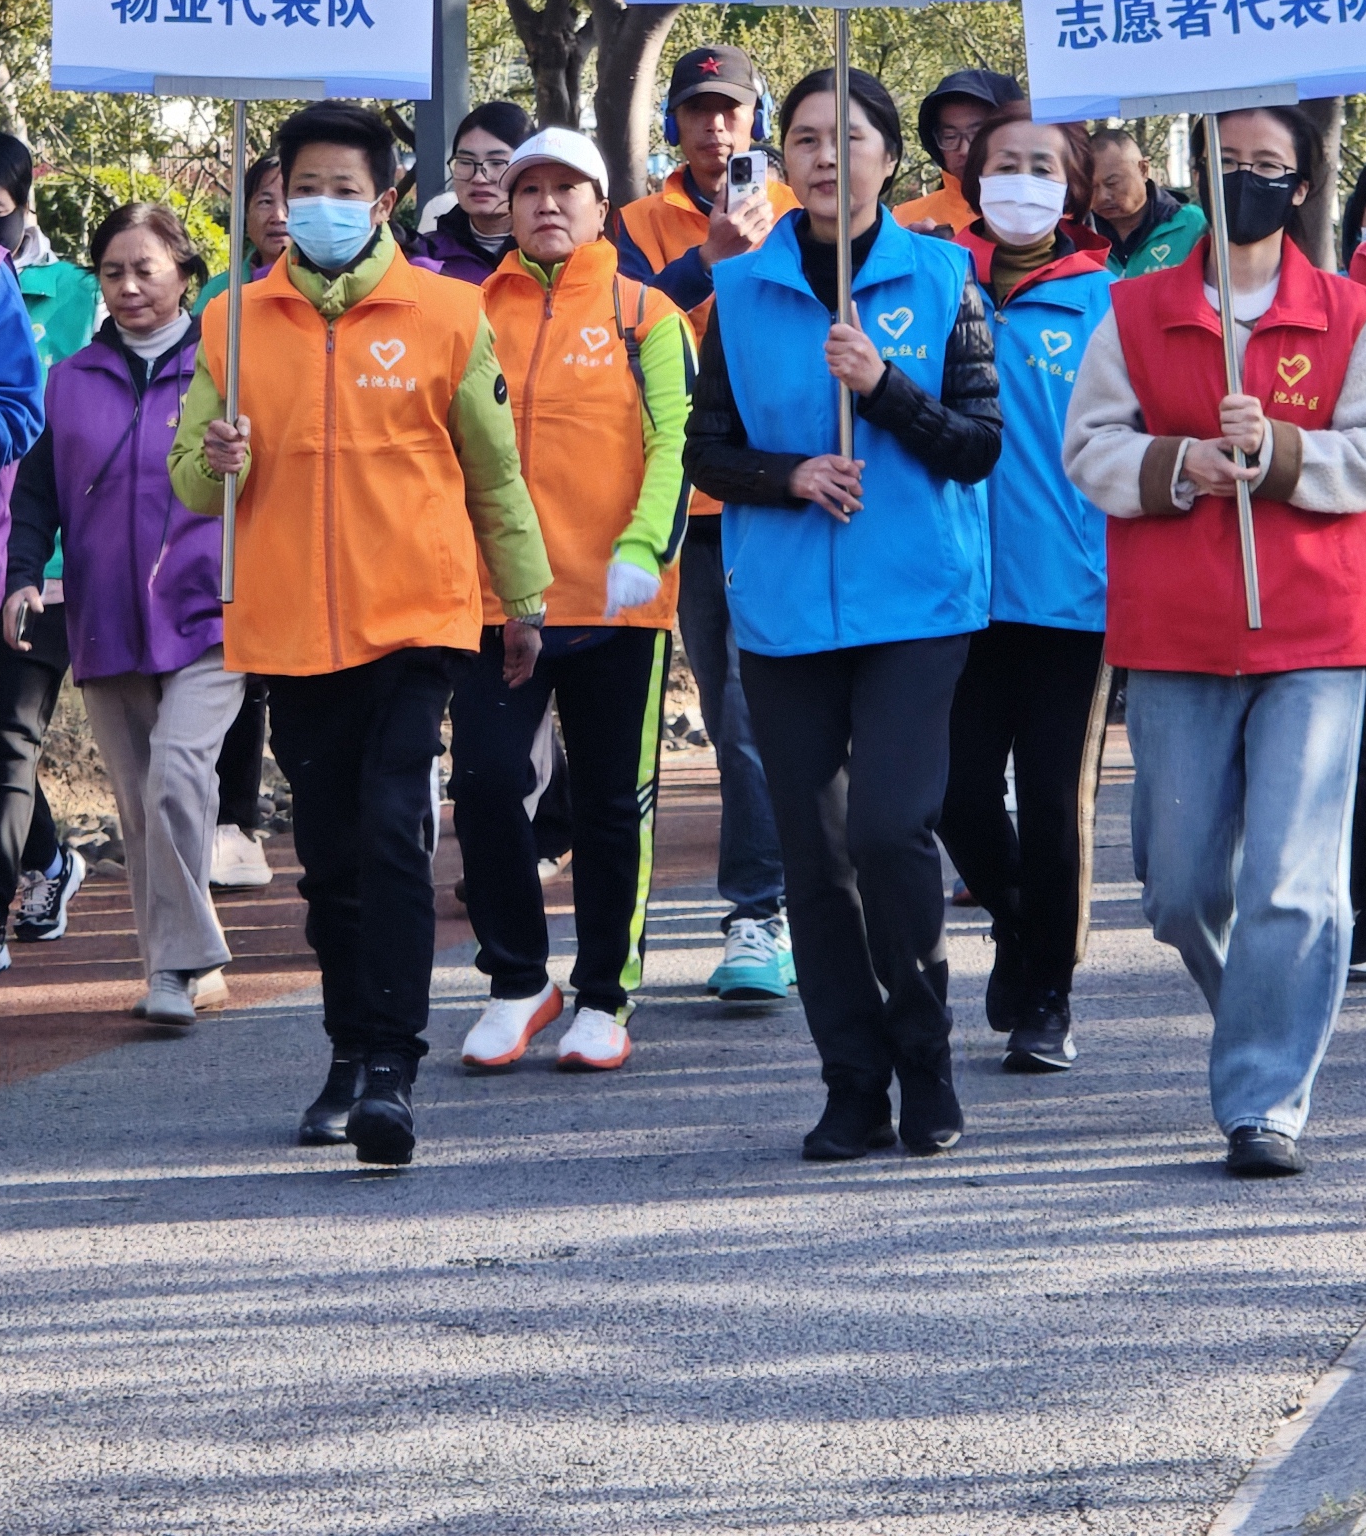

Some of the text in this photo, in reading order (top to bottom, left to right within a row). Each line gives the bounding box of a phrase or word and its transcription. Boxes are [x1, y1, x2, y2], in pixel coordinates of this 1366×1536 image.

[882, 344, 928, 360] 池社区
[356, 374, 416, 392] 云池社区
[1274, 391, 1319, 410] 池社区
